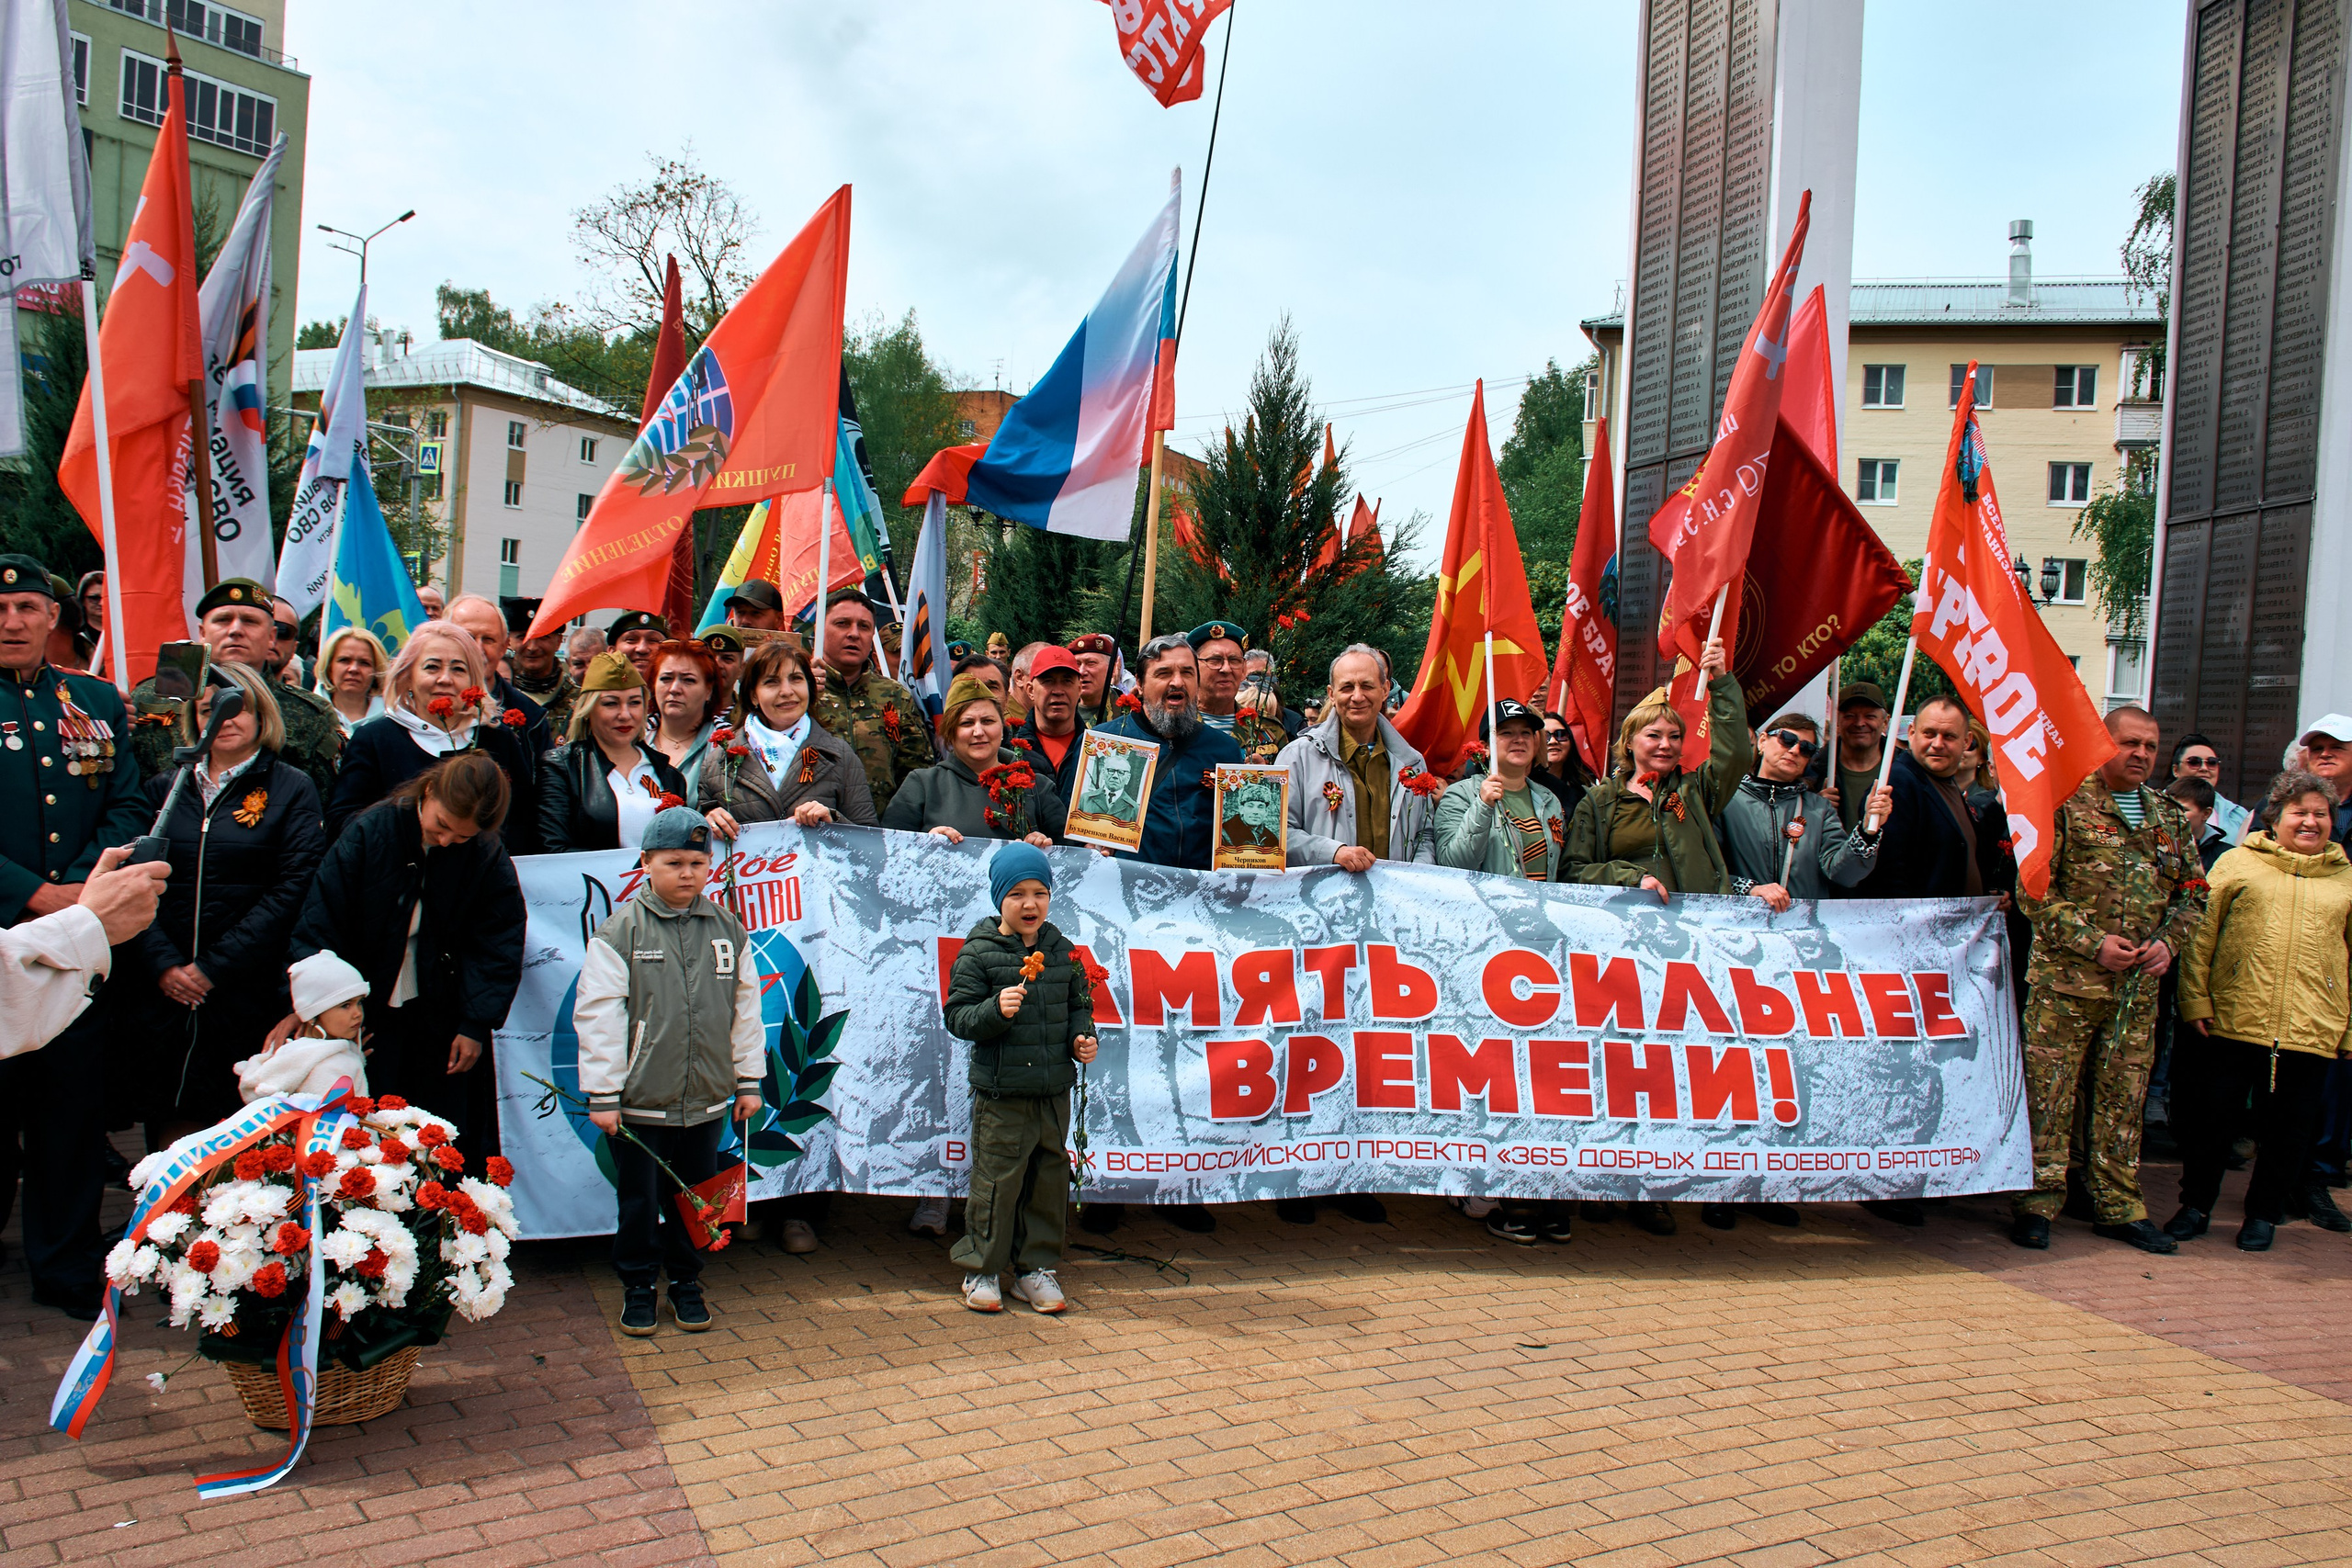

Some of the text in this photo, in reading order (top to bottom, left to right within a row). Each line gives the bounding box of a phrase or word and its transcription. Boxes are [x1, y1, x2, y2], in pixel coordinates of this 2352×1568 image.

[1732, 41, 1746, 56] АГЕЕВ
[2242, 73, 2262, 89] БАЗЛОВ
[2292, 66, 2322, 88] БАЛАНДИН
[1650, 77, 1668, 95] АБРАМОВ
[1689, 78, 1707, 95] АВЕРБАХ
[1688, 93, 1704, 108] АВЕРИН
[1730, 96, 1743, 110] АГЕЕВ
[2241, 97, 2263, 114] БАЗУНОВ
[1729, 104, 1752, 123] АГЕЕЧКИН
[2289, 107, 2315, 127] БАЛАХИН
[2194, 124, 2211, 138] БАБАЕВ
[1728, 130, 1752, 151] АГЛИЦКИЙ
[1647, 153, 1664, 169] АБРАМОВ
[2193, 148, 2210, 162] БАБАЕВ
[1727, 161, 1745, 178] АГУРЕЕВ
[2191, 181, 2212, 197] БАБАНОВ
[2285, 173, 2311, 191] БАЛАШОВ
[1725, 185, 1750, 205] АДУЙСКИЙ
[2232, 235, 2251, 250] БАЙКОВ
[1680, 250, 1697, 264] АВИЛОВ
[1679, 275, 1701, 291] АГАЛЬЦОВ
[1721, 273, 1738, 288] АЗАРОВ
[1720, 287, 1738, 301] АЗАРОВ
[1677, 303, 1696, 317] АГАПЕЕВ
[2228, 296, 2254, 311] БАКАСТОВ
[2276, 306, 2296, 320] БАЛУЕВ
[2275, 317, 2299, 333] БАЛУКОВ
[1637, 331, 1656, 344] АБРАМОВ
[2274, 328, 2307, 346] БАЛЮКЕВИЧ
[1637, 343, 1657, 357] АБРАМОВА
[2272, 354, 2308, 372] БАЛЯСНИКОВ
[1672, 410, 1688, 422] АГАПОВ
[1671, 436, 1693, 449] АГАФОНОВ
[1771, 655, 1797, 681] ТО
[1796, 614, 1842, 660] КТО?
[2251, 676, 2275, 685] БАЧИЛИН
[1504, 702, 1524, 714] Z
[1069, 824, 1138, 845] Бухаренков Василий
[711, 938, 735, 974] B
[1481, 949, 1969, 1038] СИЛЬНЕЕ
[1205, 1031, 1799, 1123] ВРЕМЕНИ!
[946, 1140, 967, 1162] В
[1107, 1139, 1350, 1173] ВСЕРОССИЙСКОГО
[1358, 1139, 1487, 1163] ПРОЕКТА
[1497, 1146, 1568, 1166] «365
[1577, 1149, 1694, 1170] ДОБРЫХ
[1703, 1152, 1758, 1171] ДЕЛ
[1767, 1152, 1871, 1171] БОЕВОГО
[1878, 1146, 1981, 1171] БРАТСТВА»
